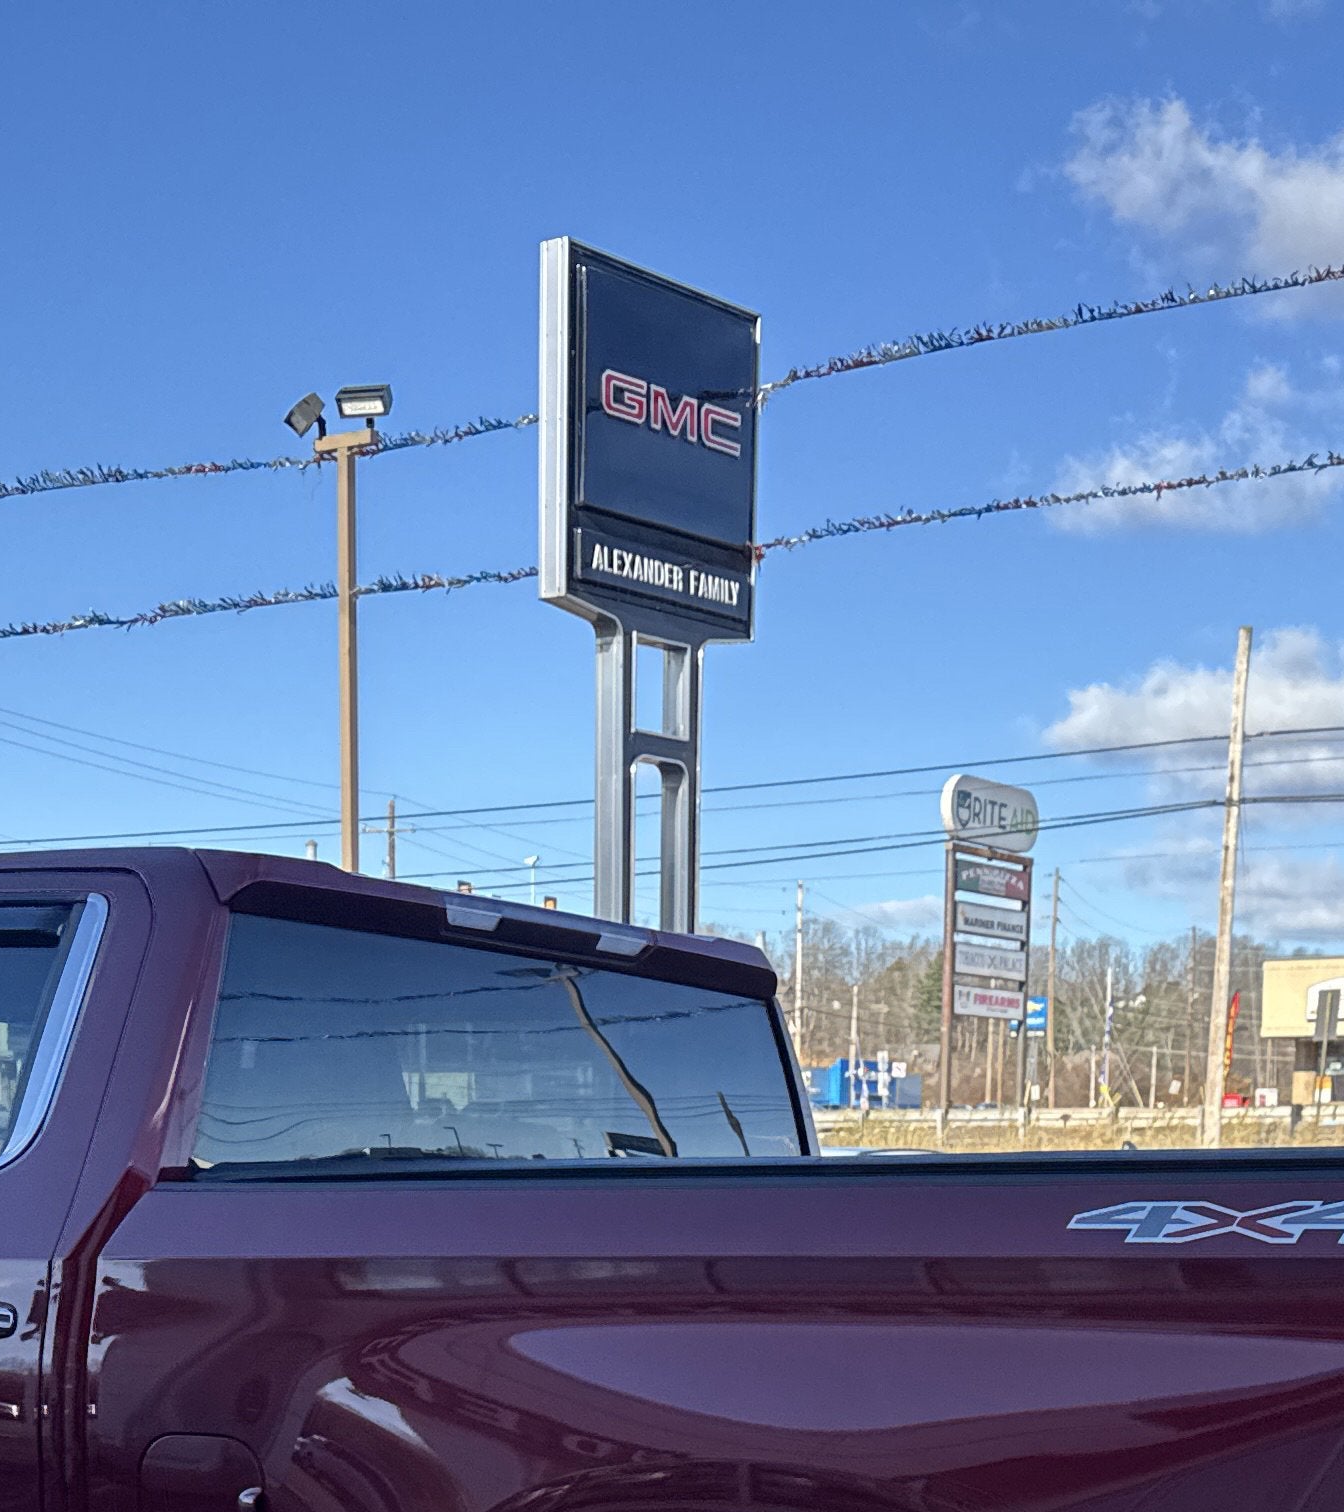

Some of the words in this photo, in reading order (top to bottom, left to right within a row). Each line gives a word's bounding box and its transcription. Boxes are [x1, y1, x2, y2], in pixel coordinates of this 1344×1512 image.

[600, 368, 742, 457] GMC
[591, 543, 683, 592] ALEXANDER
[689, 569, 739, 606] FAMILY
[973, 796, 1008, 830] RITE
[1010, 807, 1036, 835] AID
[964, 916, 995, 930] MARINER
[997, 921, 1024, 934] FINANCE
[973, 992, 1020, 1009] FIREARMS
